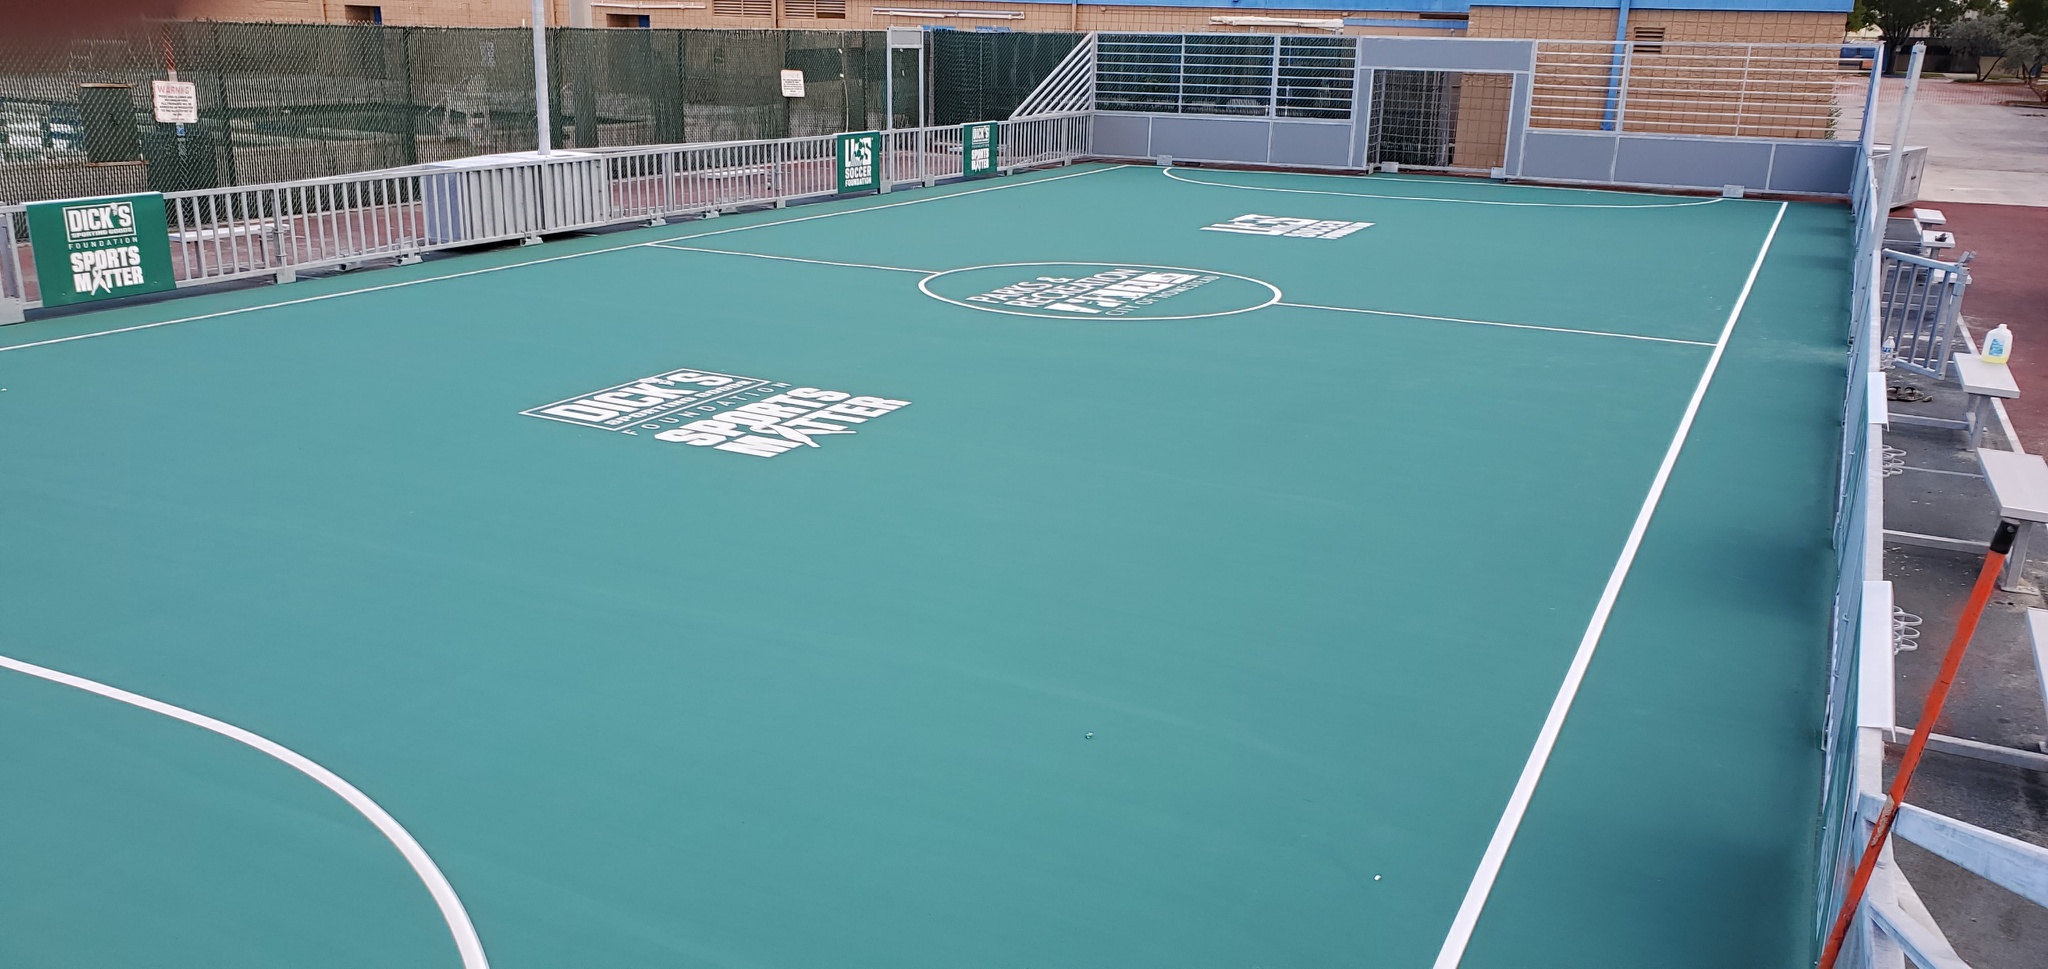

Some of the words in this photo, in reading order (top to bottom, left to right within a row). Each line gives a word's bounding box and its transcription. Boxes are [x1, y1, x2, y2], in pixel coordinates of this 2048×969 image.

[845, 166, 871, 179] SOCCER
[67, 203, 131, 232] DICK'S
[68, 237, 138, 251] FOUNDATION
[71, 230, 108, 238] SPORTING
[70, 245, 141, 273] SPORTS
[964, 281, 1053, 304] PARKS
[1003, 268, 1147, 308] RECREATION
[1105, 304, 1141, 316] CITY
[540, 372, 734, 423] DICK'S
[603, 396, 698, 426] SPORTING
[620, 381, 792, 436] FOUNDATION
[654, 387, 851, 446] SPORTS
